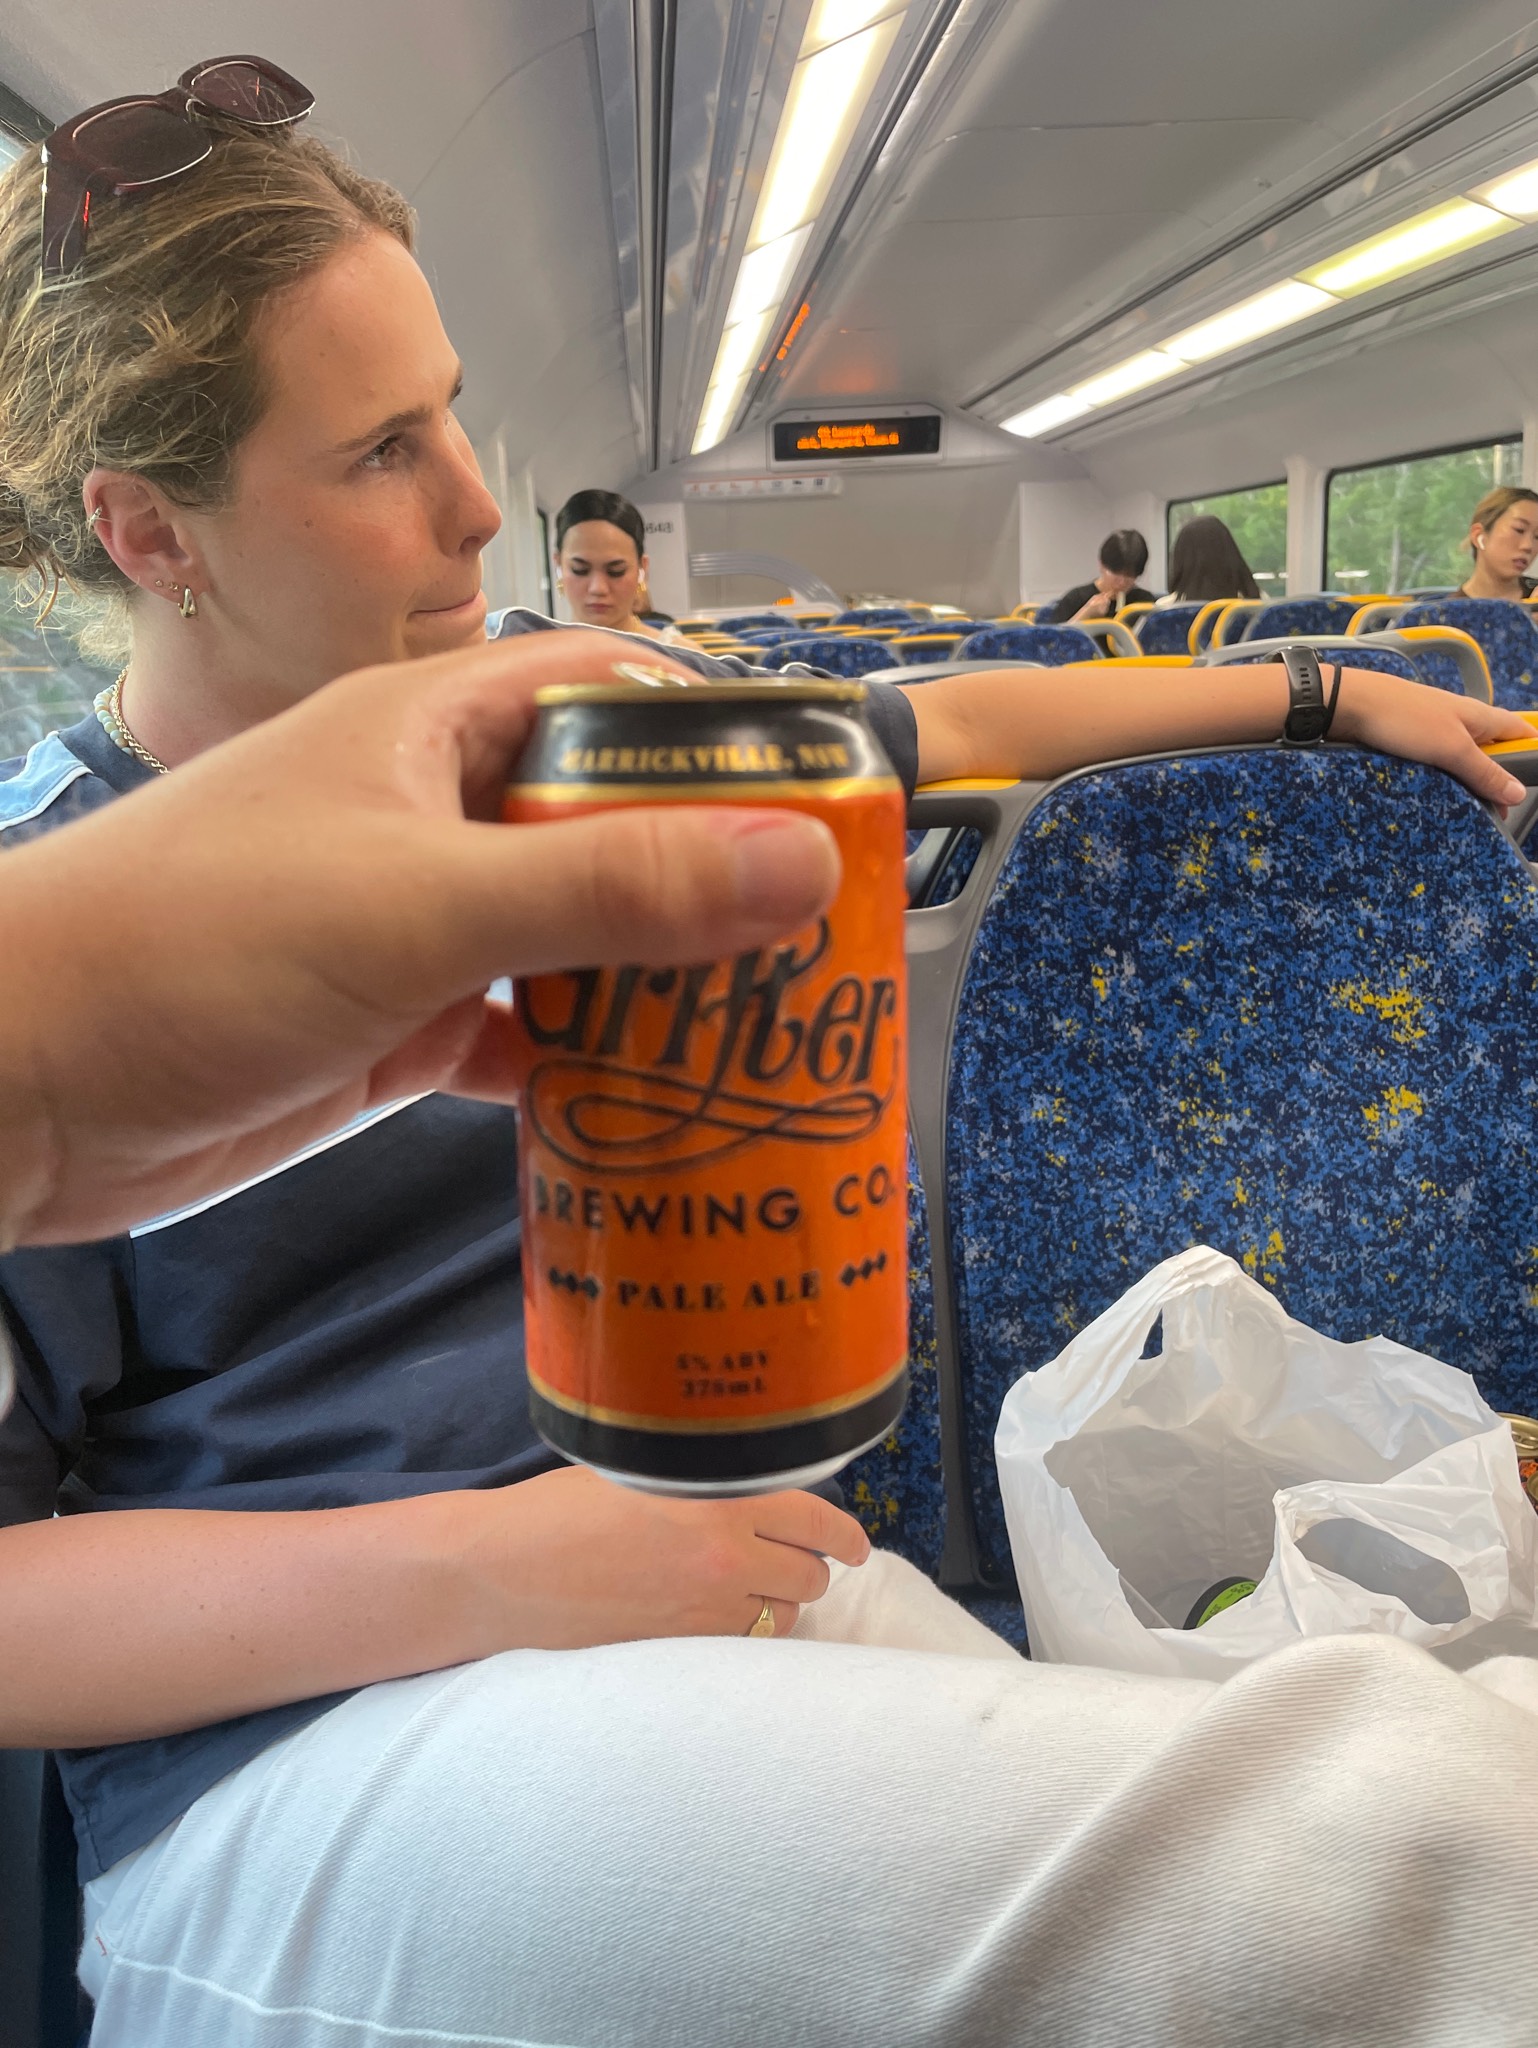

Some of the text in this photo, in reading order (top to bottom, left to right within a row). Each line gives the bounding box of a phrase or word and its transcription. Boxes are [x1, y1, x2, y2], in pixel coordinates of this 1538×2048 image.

[534, 1173, 802, 1237] BREWING
[617, 1271, 822, 1312] PALE ALE
